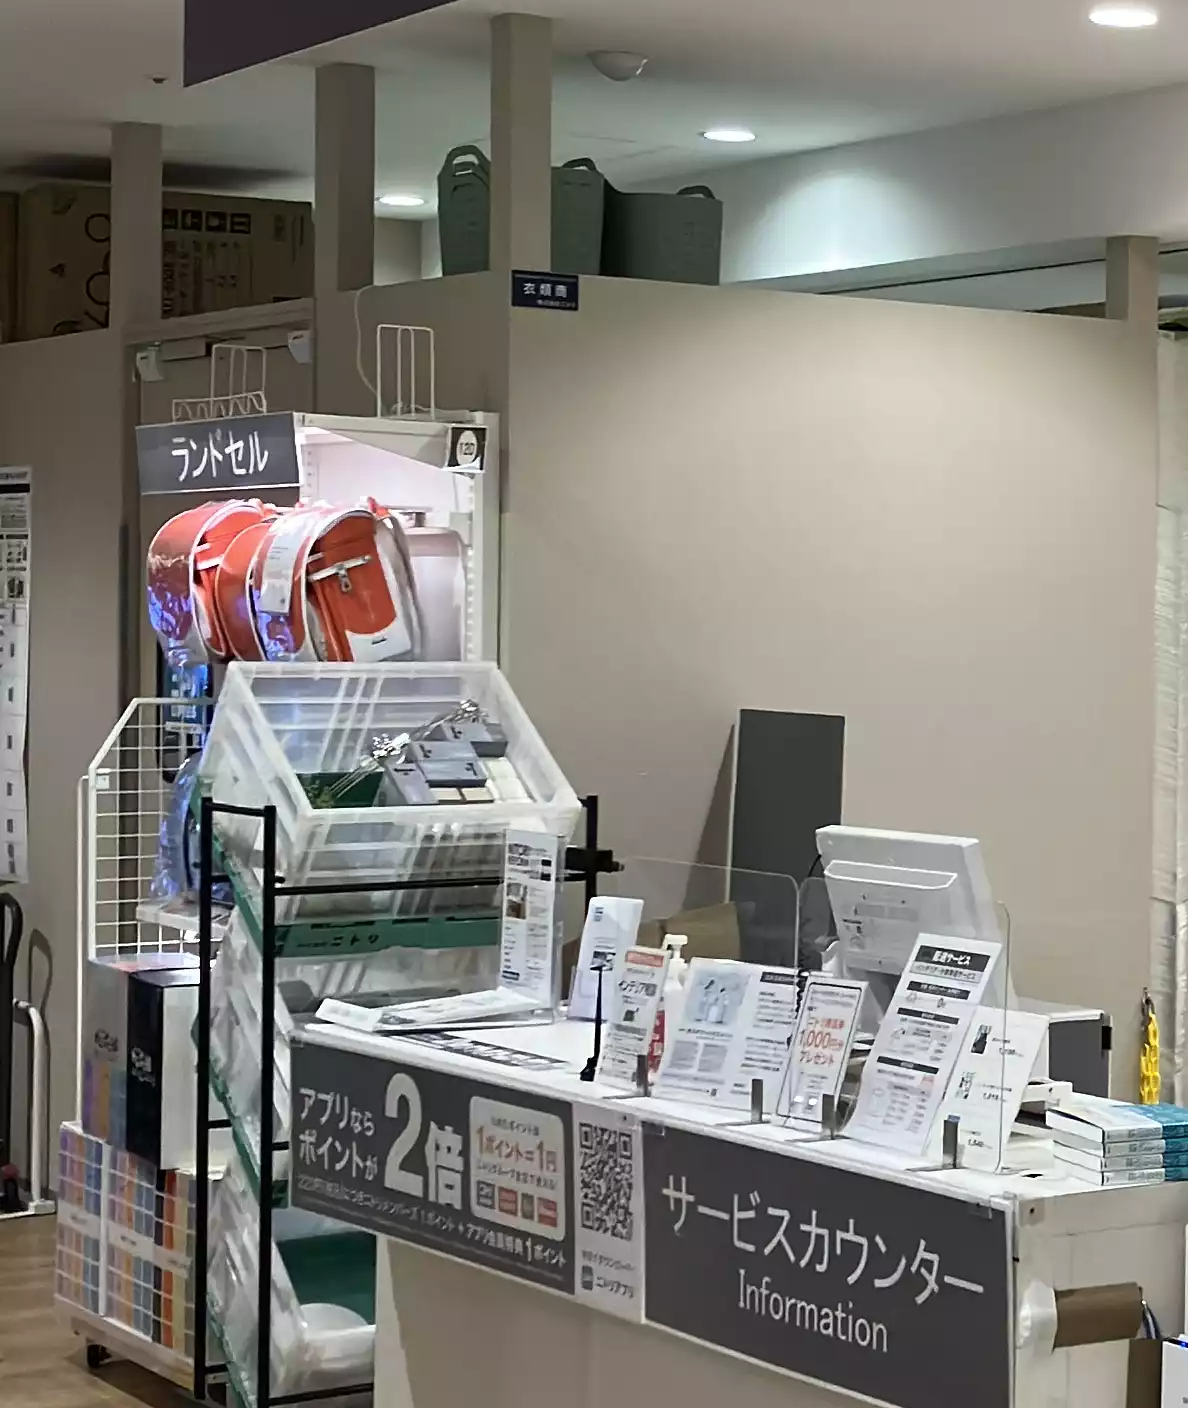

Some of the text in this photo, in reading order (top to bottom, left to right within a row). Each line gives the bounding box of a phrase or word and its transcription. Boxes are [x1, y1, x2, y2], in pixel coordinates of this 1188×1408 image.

[170, 429, 270, 481] ランドセル
[384, 1072, 464, 1211] 2倍
[661, 1174, 985, 1305] サービスカウンター
[737, 1268, 888, 1354] Information
